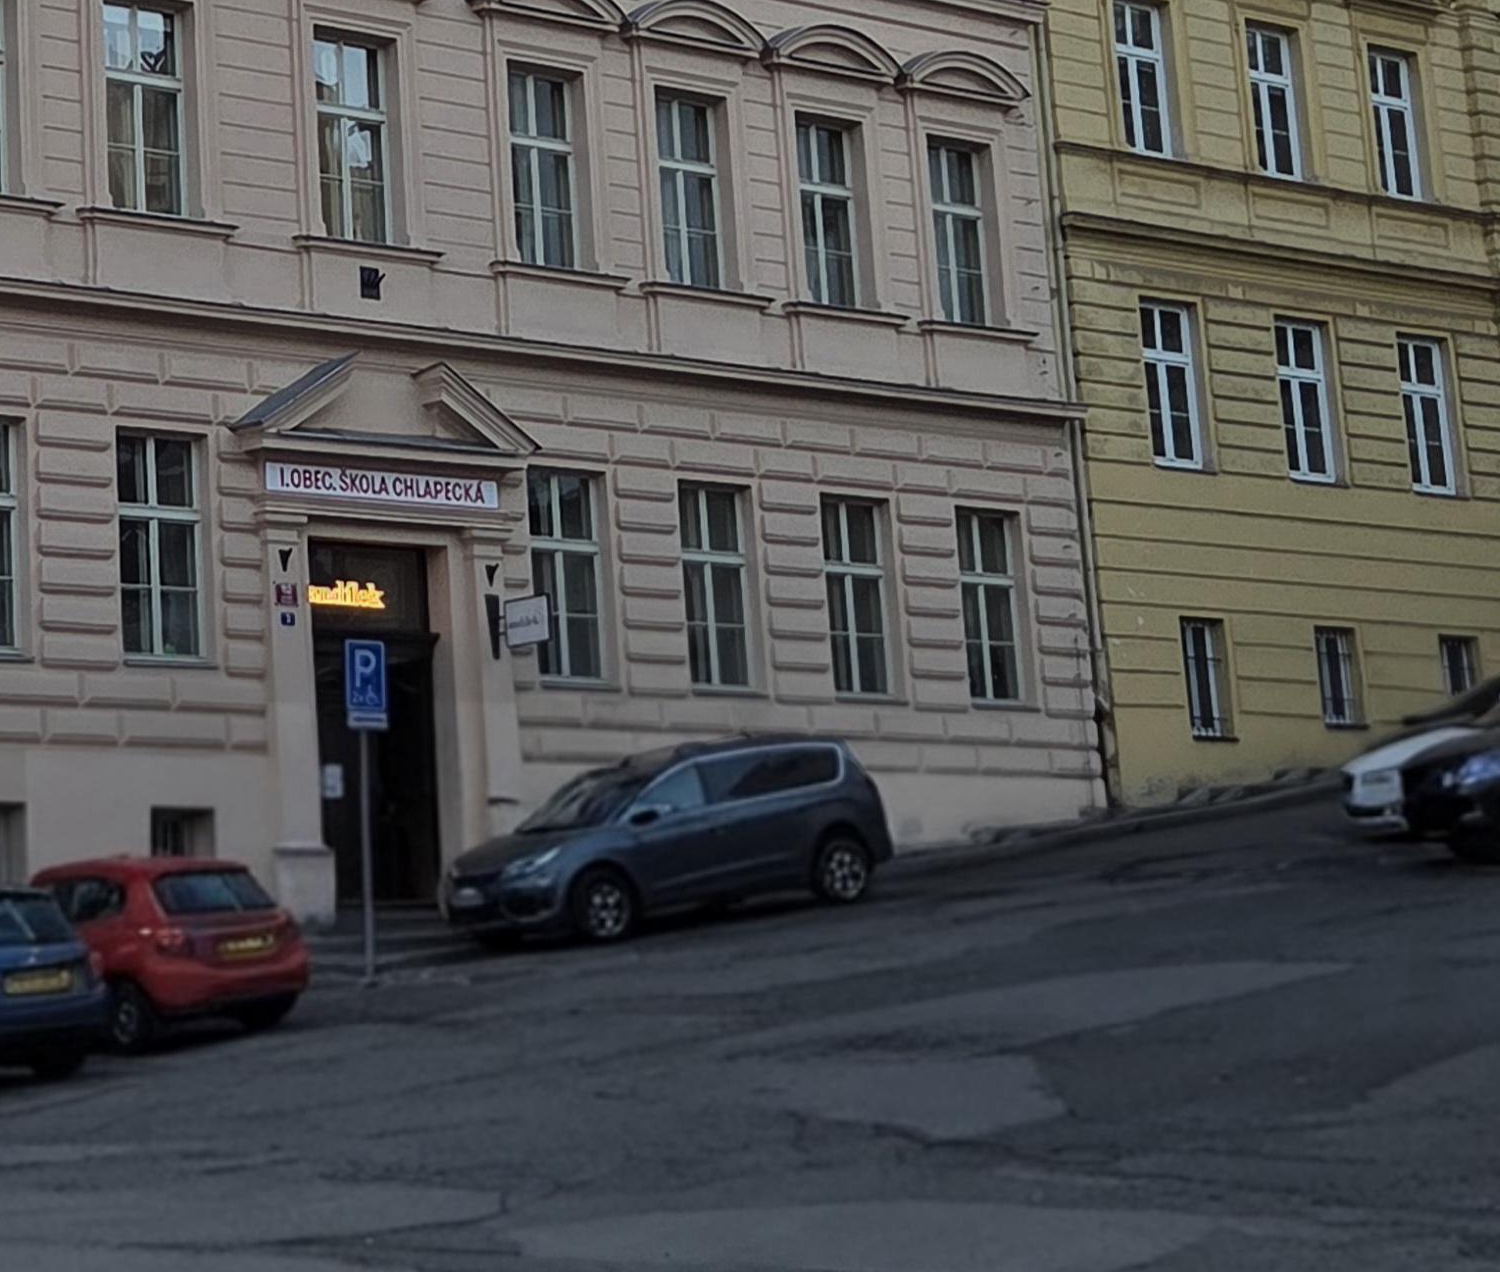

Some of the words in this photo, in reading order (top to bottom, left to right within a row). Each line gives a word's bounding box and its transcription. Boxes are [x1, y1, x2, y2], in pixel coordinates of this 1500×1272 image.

[339, 467, 390, 496] ŠKOLA
[392, 477, 486, 504] CHLAPECKÁ
[354, 648, 377, 687] P
